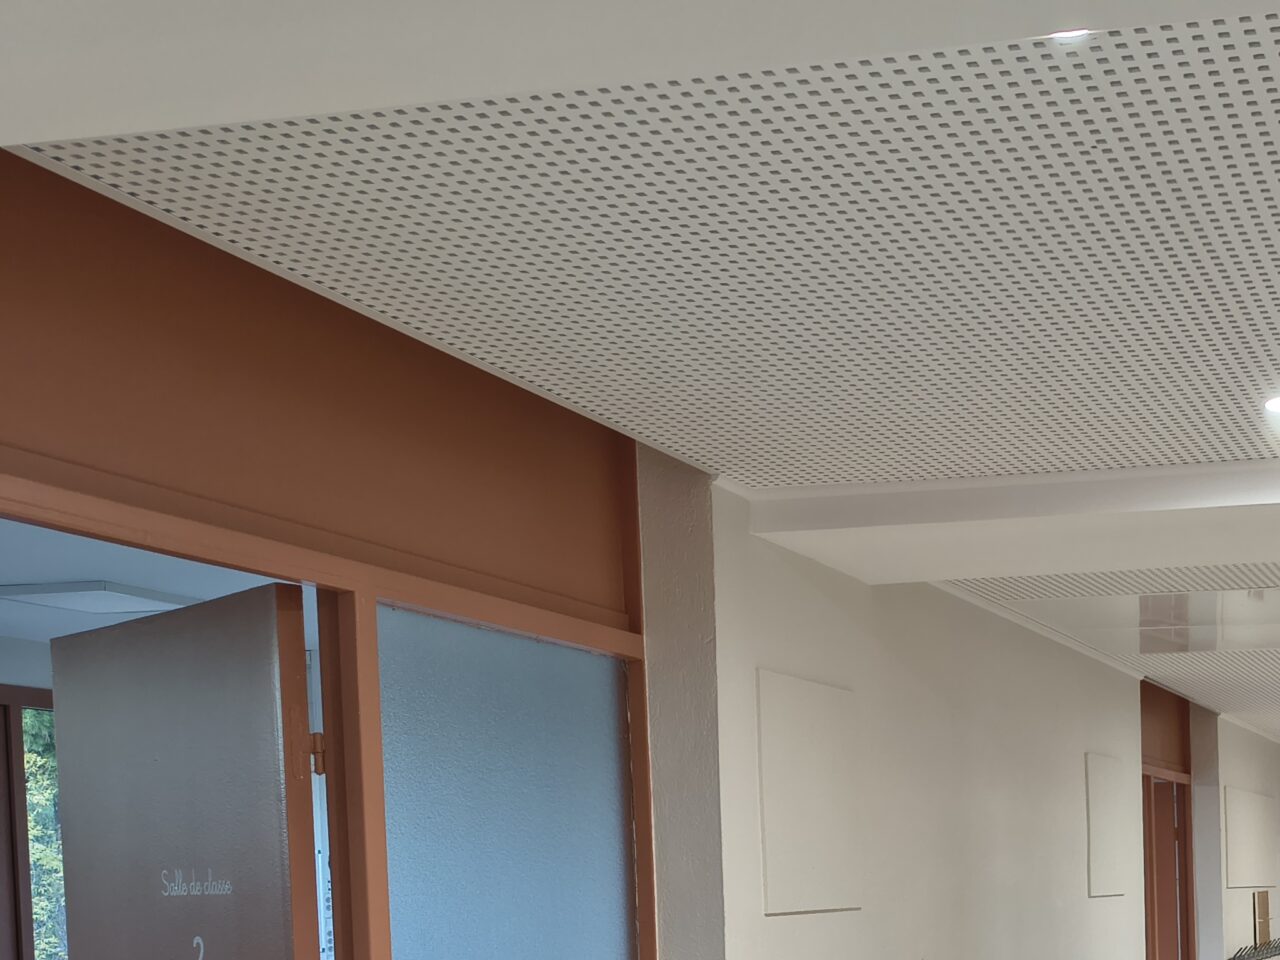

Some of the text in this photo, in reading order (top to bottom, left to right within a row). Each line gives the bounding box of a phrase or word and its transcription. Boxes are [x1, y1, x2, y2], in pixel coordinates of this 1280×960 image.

[161, 868, 233, 896] Salle de classe
